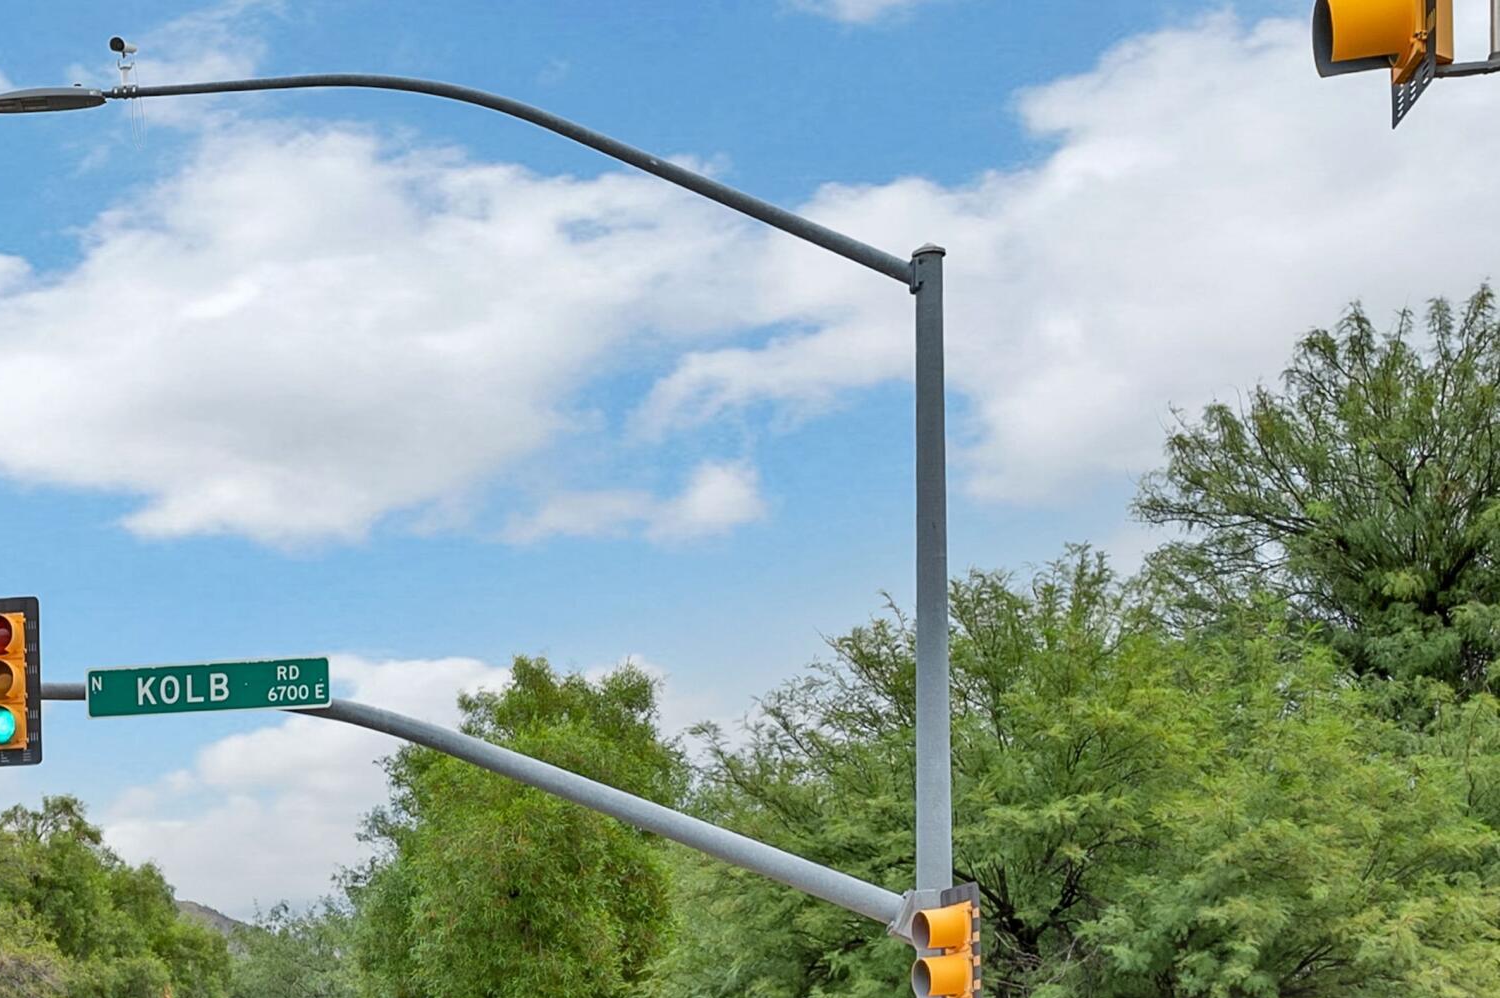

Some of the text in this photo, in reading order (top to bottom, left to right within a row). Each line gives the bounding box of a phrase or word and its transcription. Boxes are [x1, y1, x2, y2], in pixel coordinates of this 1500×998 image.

[276, 665, 300, 680] RD
[91, 673, 230, 704] N KOLB
[267, 685, 325, 701] 6700 E
